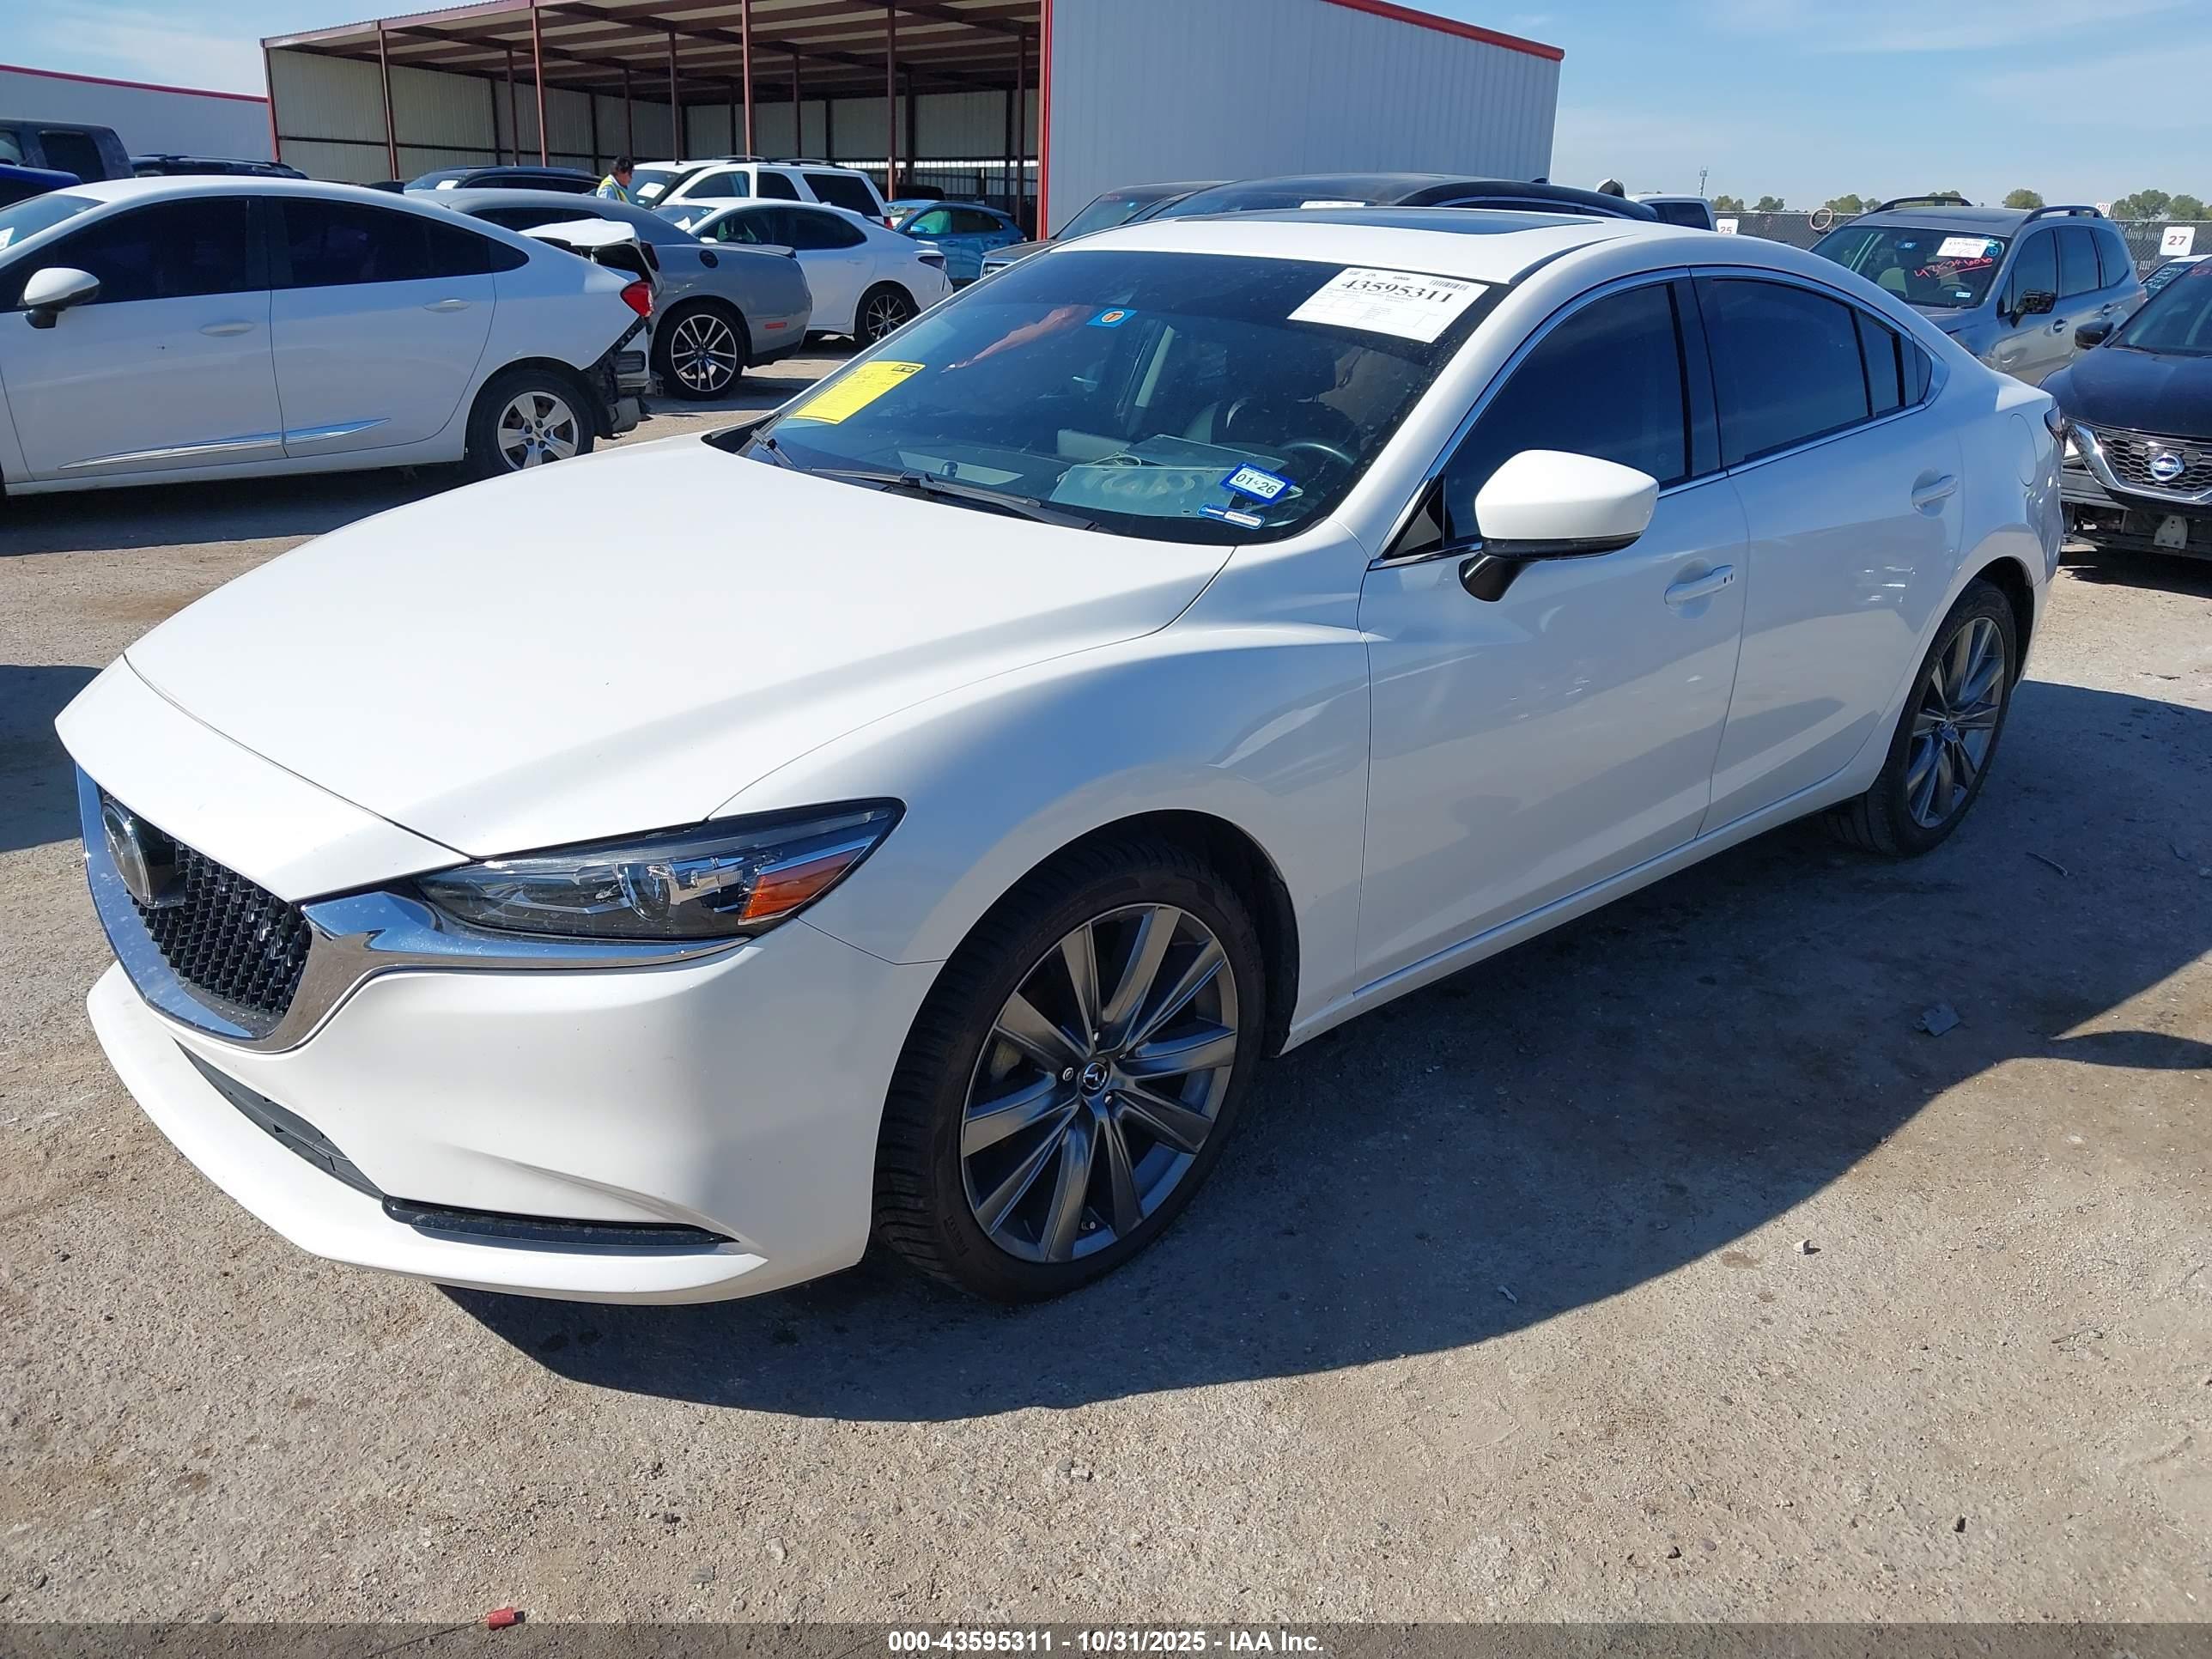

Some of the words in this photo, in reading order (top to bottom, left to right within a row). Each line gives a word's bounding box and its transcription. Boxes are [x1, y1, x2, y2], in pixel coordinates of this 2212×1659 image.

[1720, 226, 1732, 234] 25
[2167, 235, 2187, 246] 27
[1341, 279, 1454, 303] 43595311
